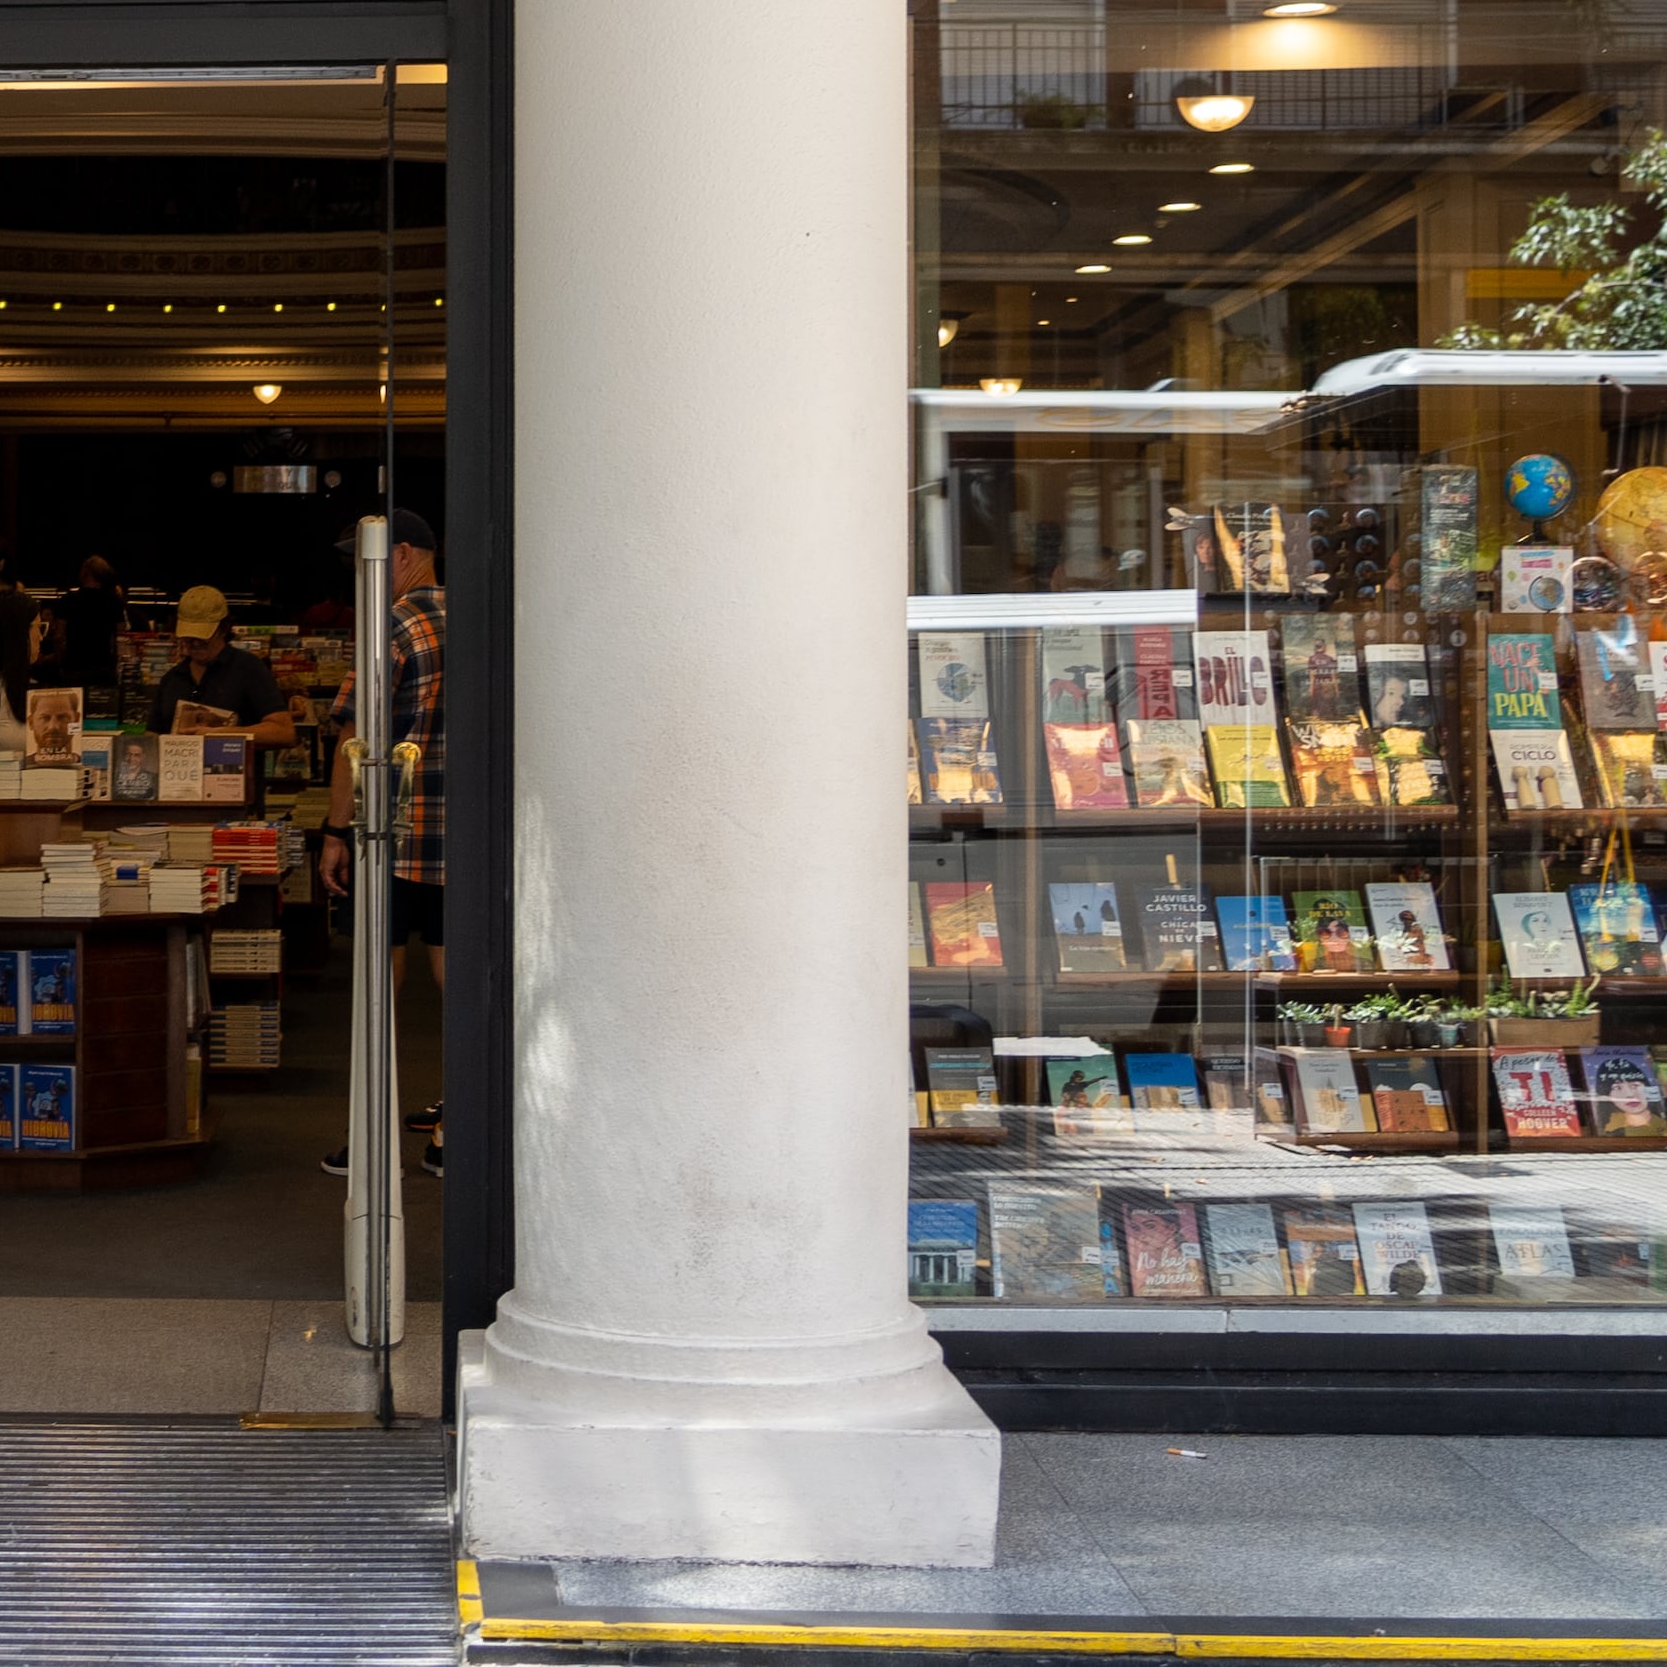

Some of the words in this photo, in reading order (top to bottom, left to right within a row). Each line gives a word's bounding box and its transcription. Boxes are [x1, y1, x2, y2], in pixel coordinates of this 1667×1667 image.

[1489, 642, 1543, 667] NACE
[1503, 667, 1535, 693] UN
[1494, 689, 1548, 718] PAPÁ
[164, 749, 198, 757] MACRI
[1511, 750, 1556, 761] CICLO
[1152, 894, 1197, 903] JAVIER
[1146, 904, 1207, 912] CASTILLO
[1160, 921, 1196, 929] CHICA
[1159, 935, 1204, 943] NIEVE
[1500, 1055, 1509, 1069] A
[1511, 1057, 1541, 1069] pesar
[1544, 1053, 1556, 1063] de
[1509, 1070, 1556, 1102] TI
[1522, 1109, 1557, 1117] COLLEEN
[1517, 1117, 1569, 1130] HOOVER
[1504, 1243, 1564, 1260] ATLAS
[1135, 1251, 1157, 1272] No
[1161, 1246, 1188, 1272] hay
